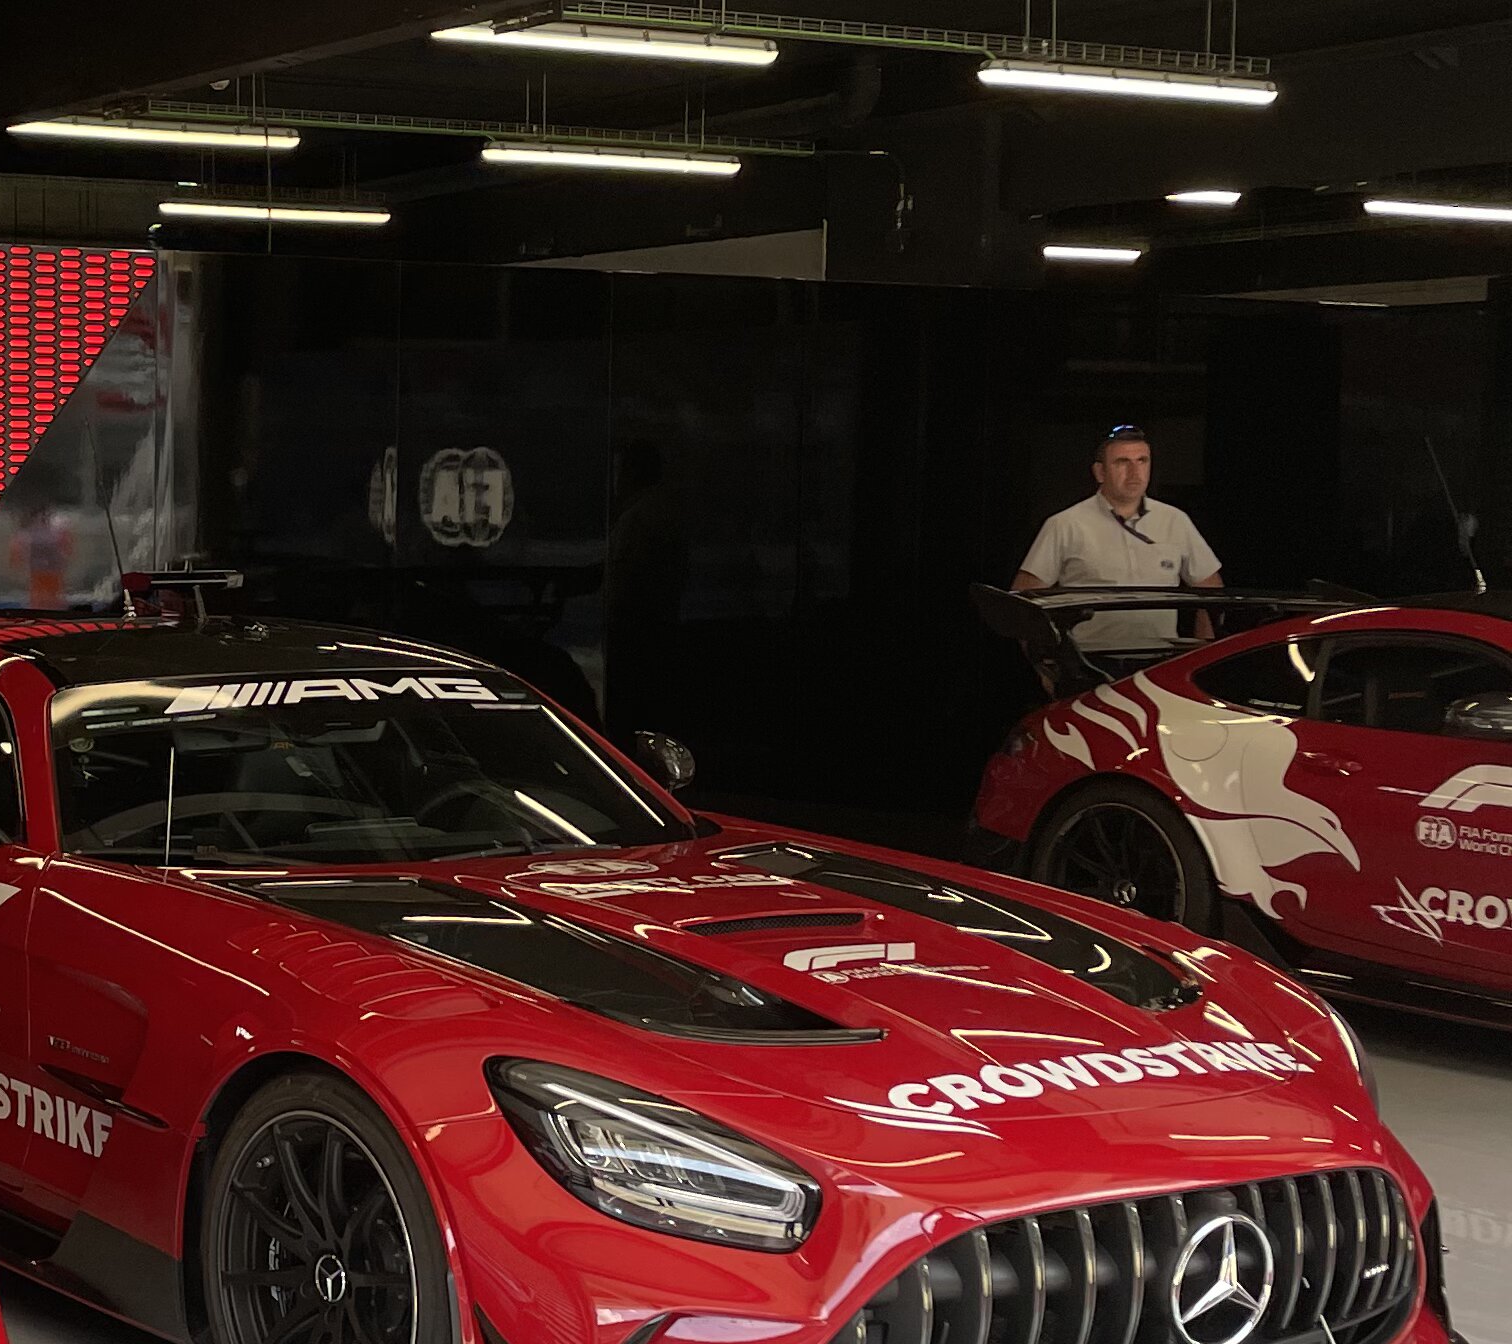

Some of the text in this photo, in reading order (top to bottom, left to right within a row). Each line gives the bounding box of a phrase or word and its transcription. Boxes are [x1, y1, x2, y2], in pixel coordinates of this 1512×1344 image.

[284, 677, 500, 704] AMG
[1419, 887, 1512, 930] CRO
[888, 1040, 1316, 1116] CROWDSTRIKE
